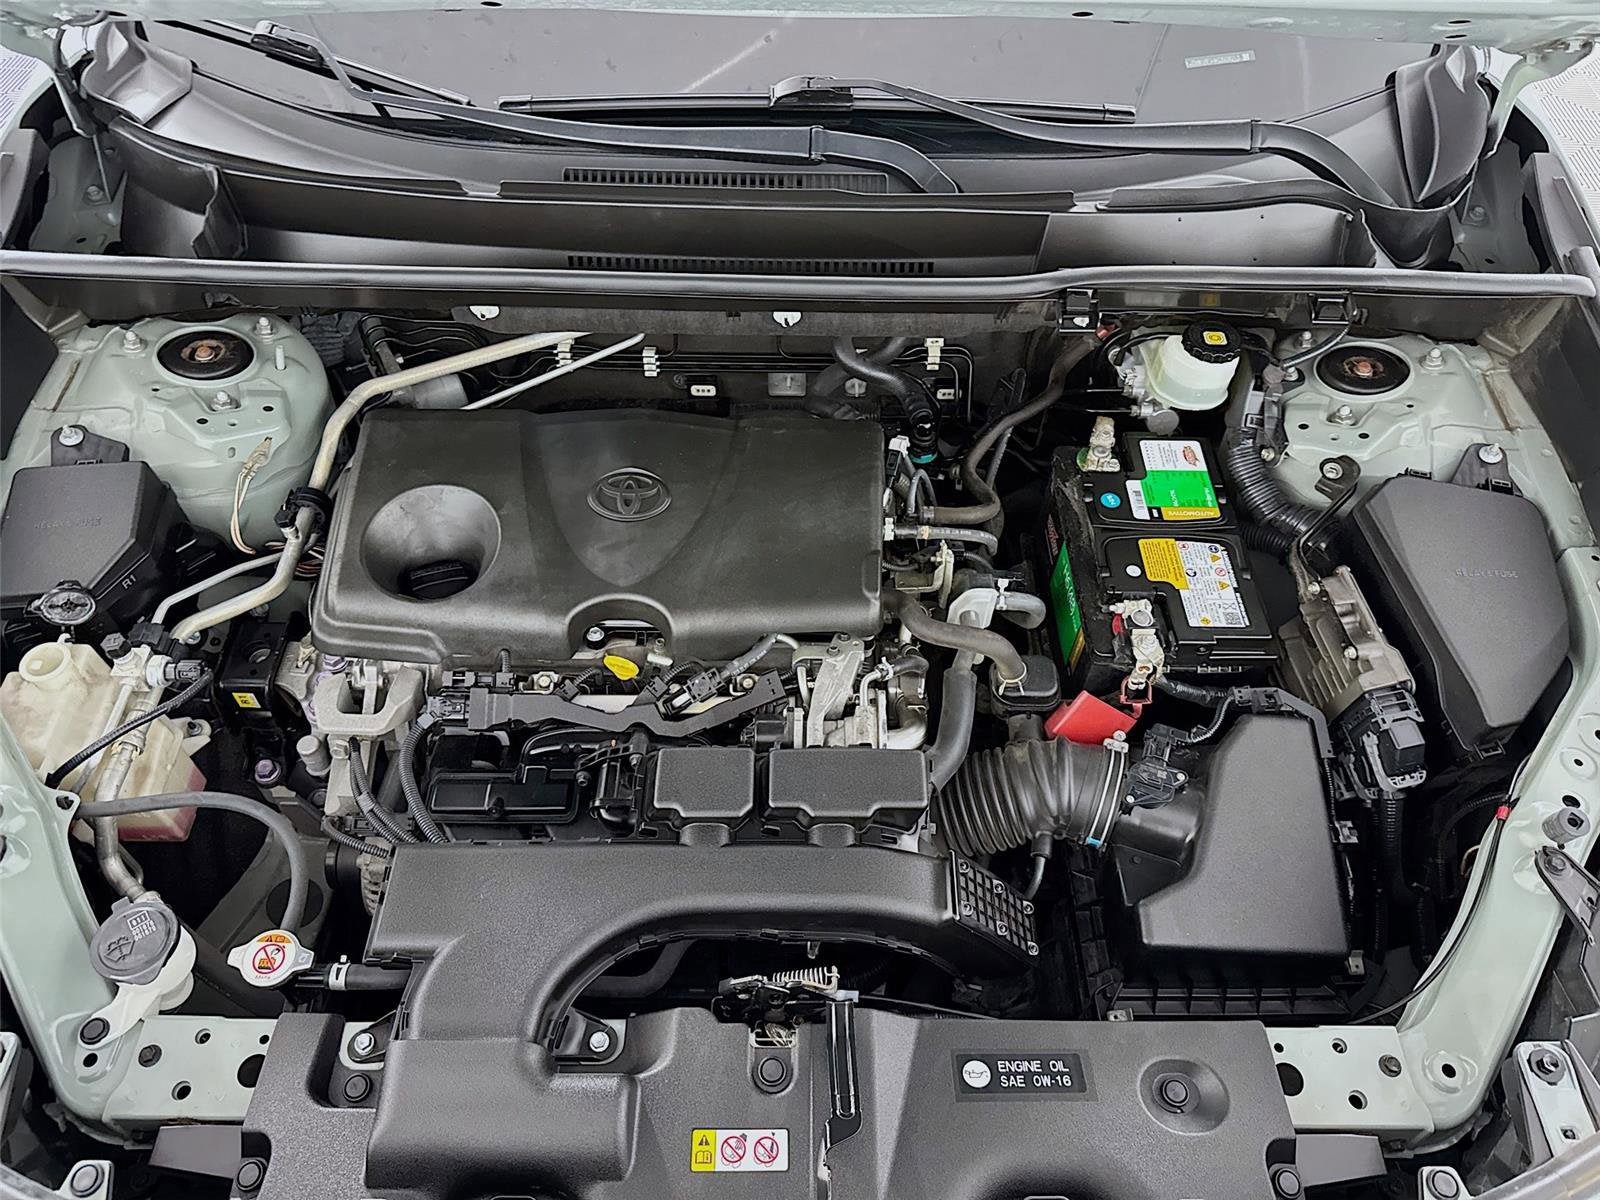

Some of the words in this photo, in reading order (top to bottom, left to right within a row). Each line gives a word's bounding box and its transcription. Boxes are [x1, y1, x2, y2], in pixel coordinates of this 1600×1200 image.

[122, 574, 136, 589] R1
[997, 1060, 1042, 1072] ENGINE
[1049, 1060, 1069, 1072] OIL
[1000, 1075, 1026, 1087] SAE
[1032, 1074, 1072, 1087] 0W-16
